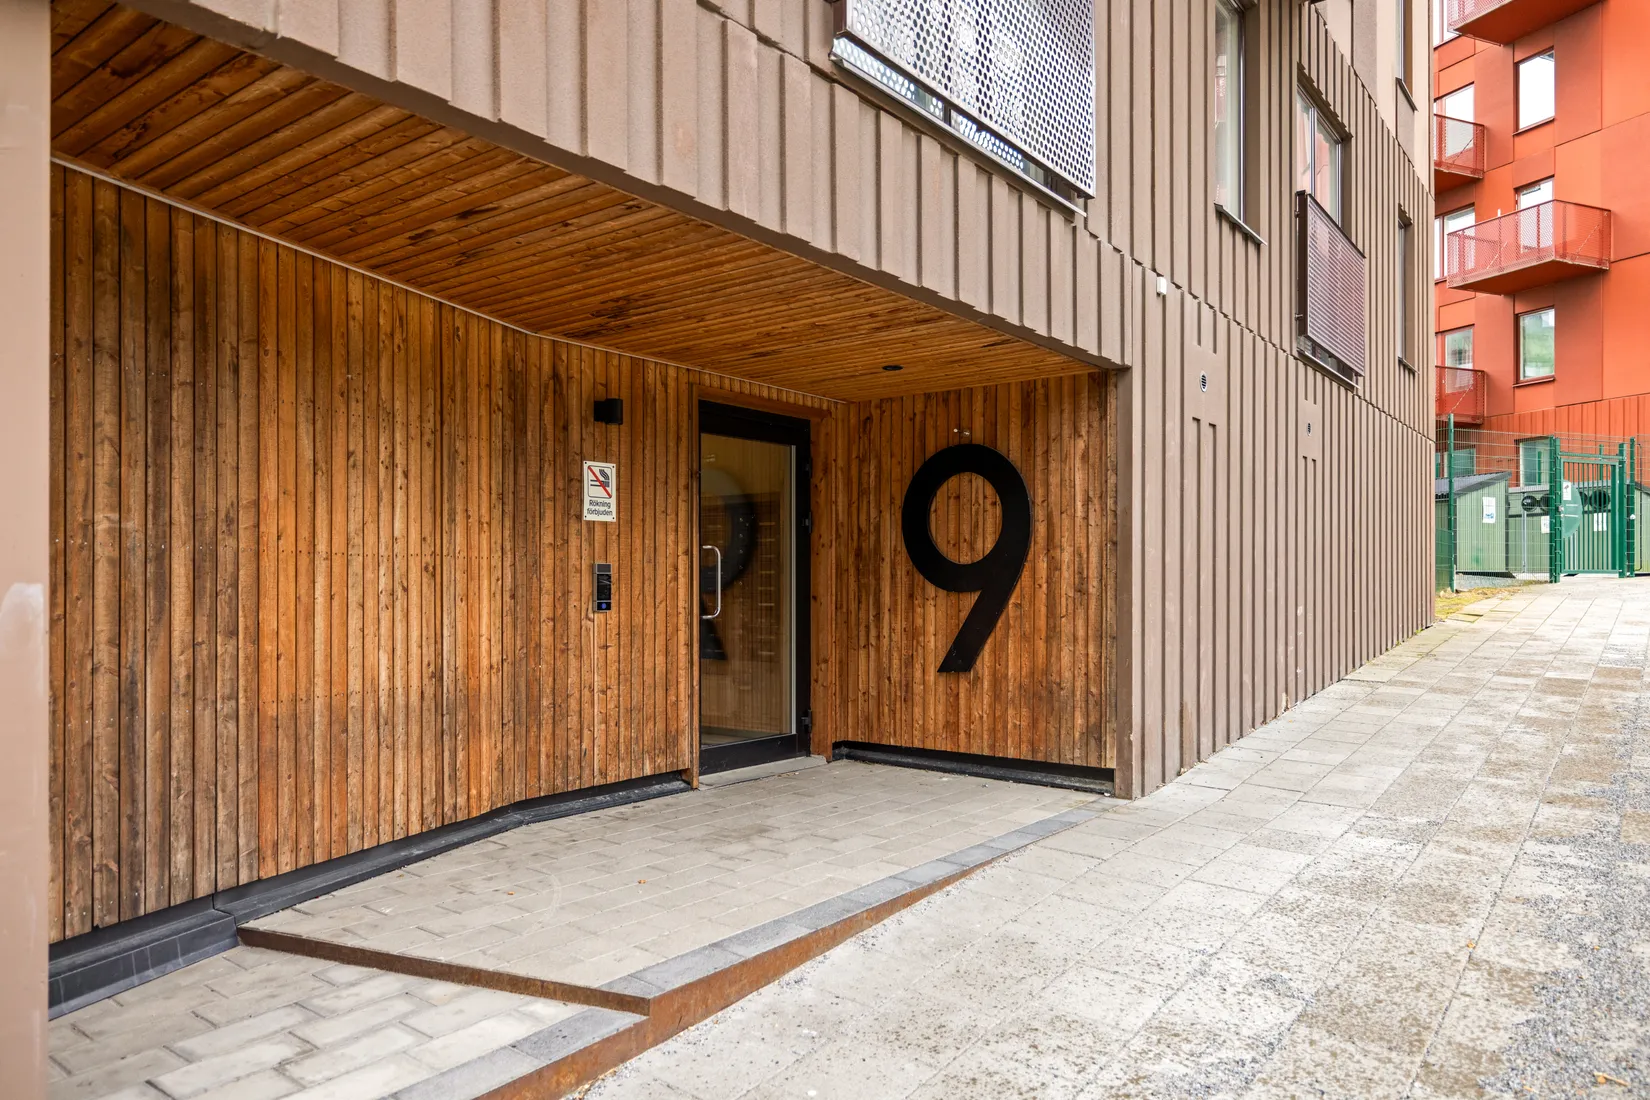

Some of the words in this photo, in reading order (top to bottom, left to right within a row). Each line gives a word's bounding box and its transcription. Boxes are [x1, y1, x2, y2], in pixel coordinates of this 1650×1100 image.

[589, 499, 611, 509] Rökning
[587, 508, 613, 516] förbjuden
[902, 443, 1033, 673] 9
